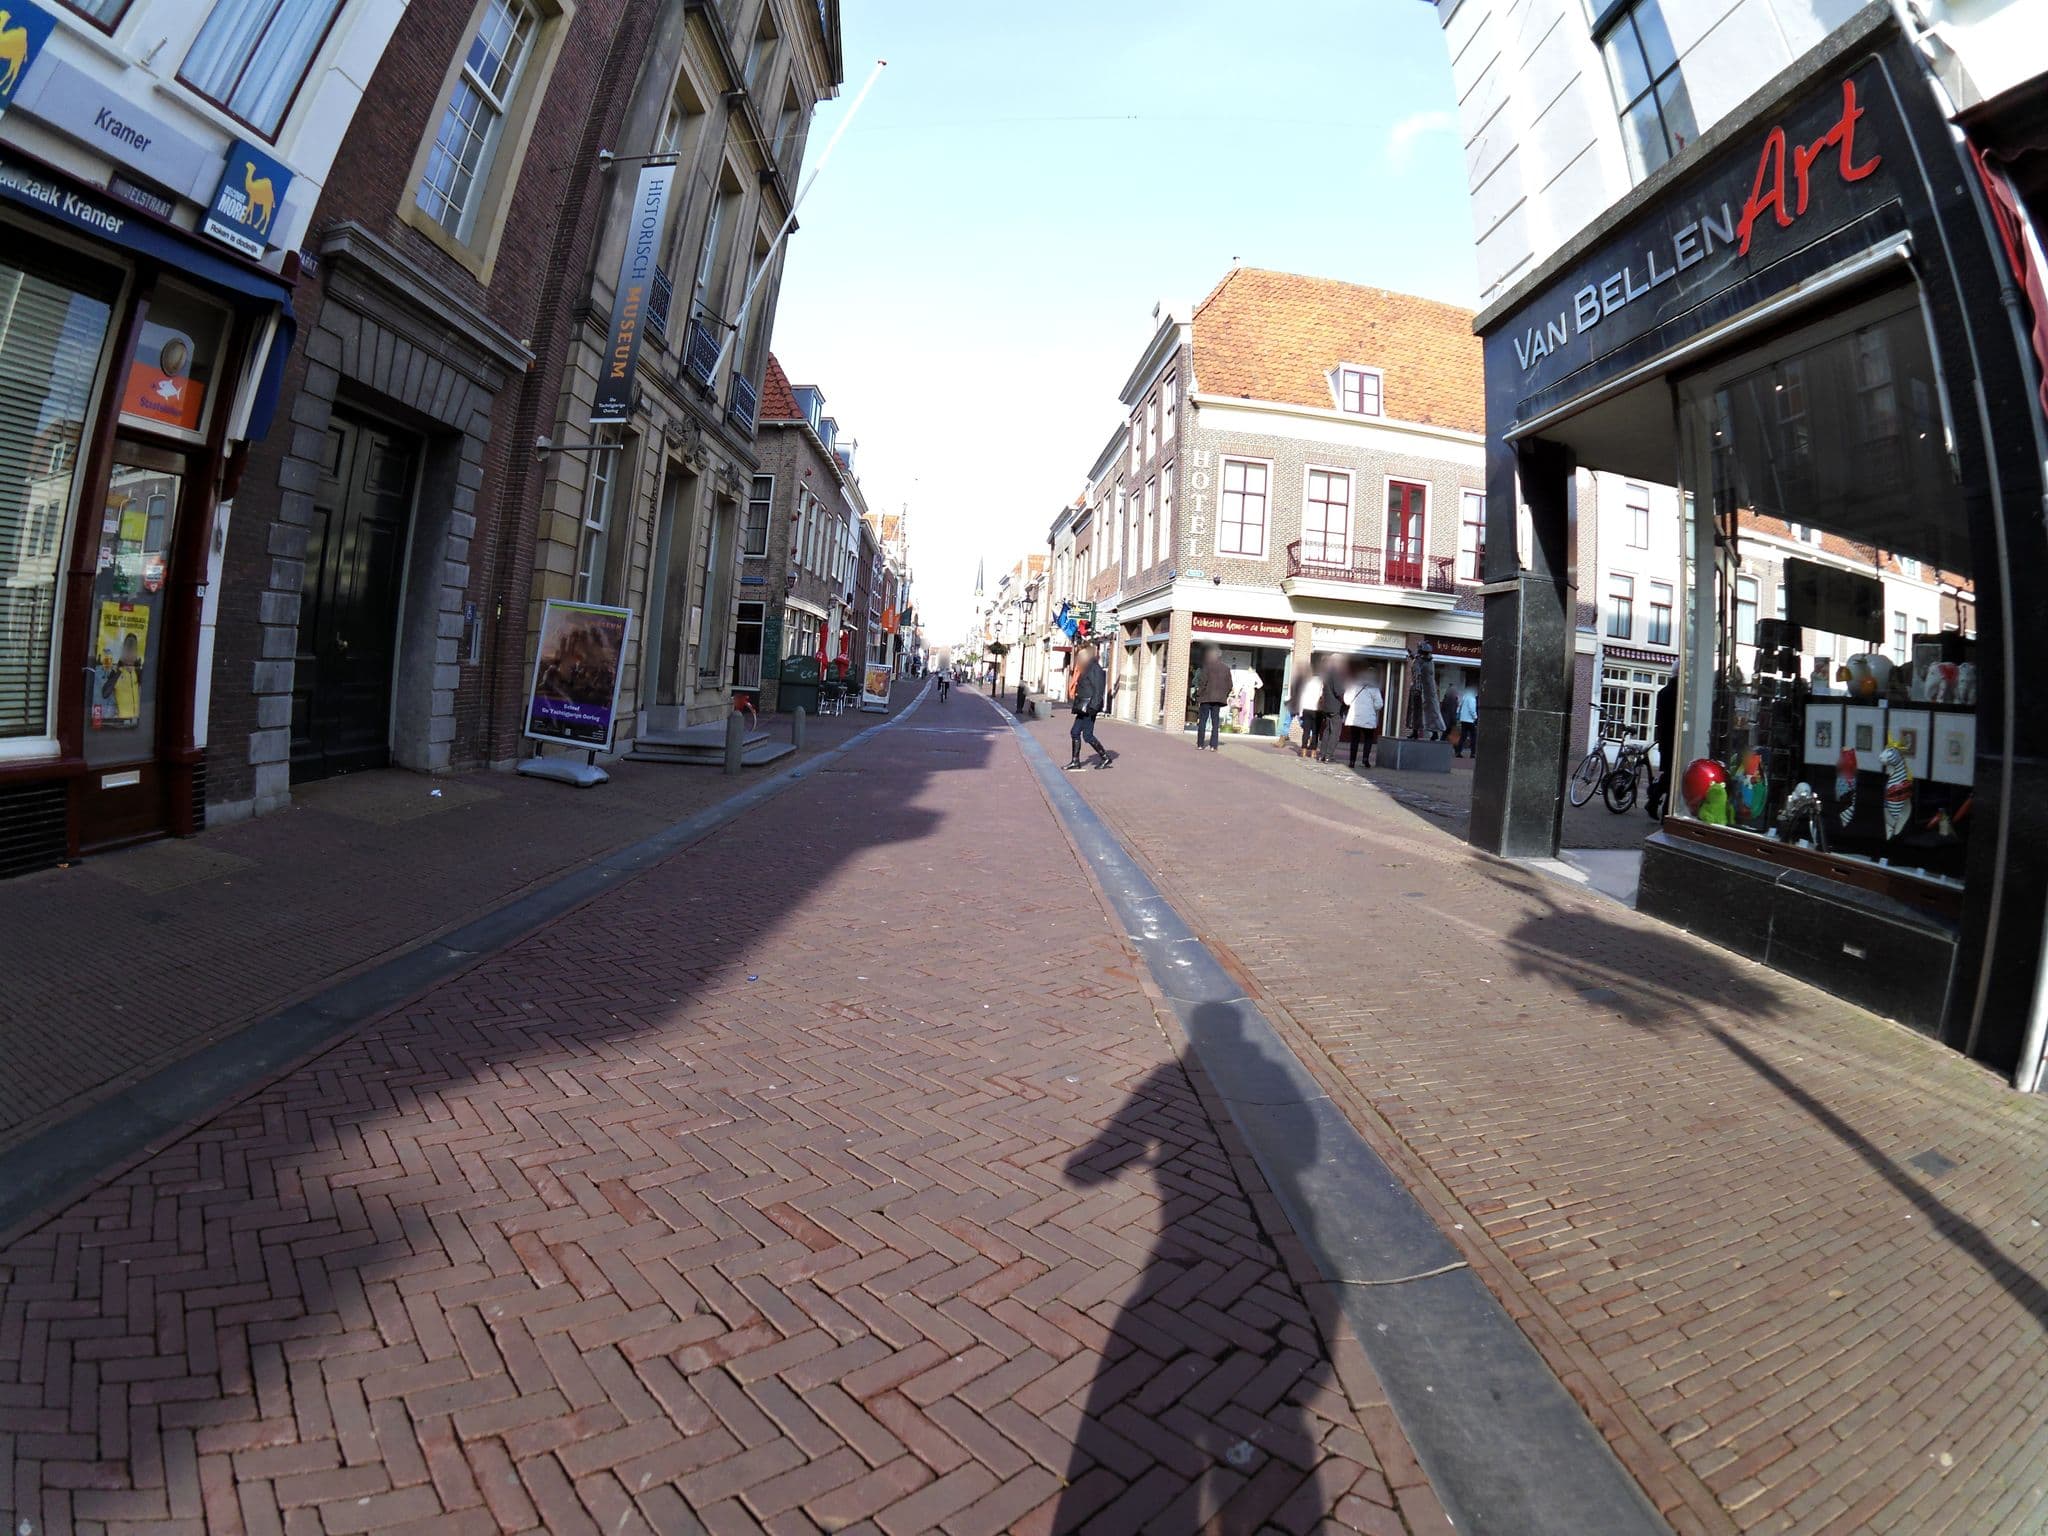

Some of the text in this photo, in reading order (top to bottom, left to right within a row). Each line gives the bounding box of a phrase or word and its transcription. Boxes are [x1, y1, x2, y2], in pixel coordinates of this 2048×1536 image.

[94, 106, 152, 152] Kramer
[63, 192, 124, 234] Kramer
[116, 177, 172, 217] ELSTRAAT
[217, 194, 248, 224] MORE
[210, 224, 258, 254] Roken is dodelijk
[1513, 78, 1882, 371] VAN BELLEN Art
[610, 179, 664, 378] HISTORISCH MUSEUM
[1188, 449, 1210, 557] HOTEL
